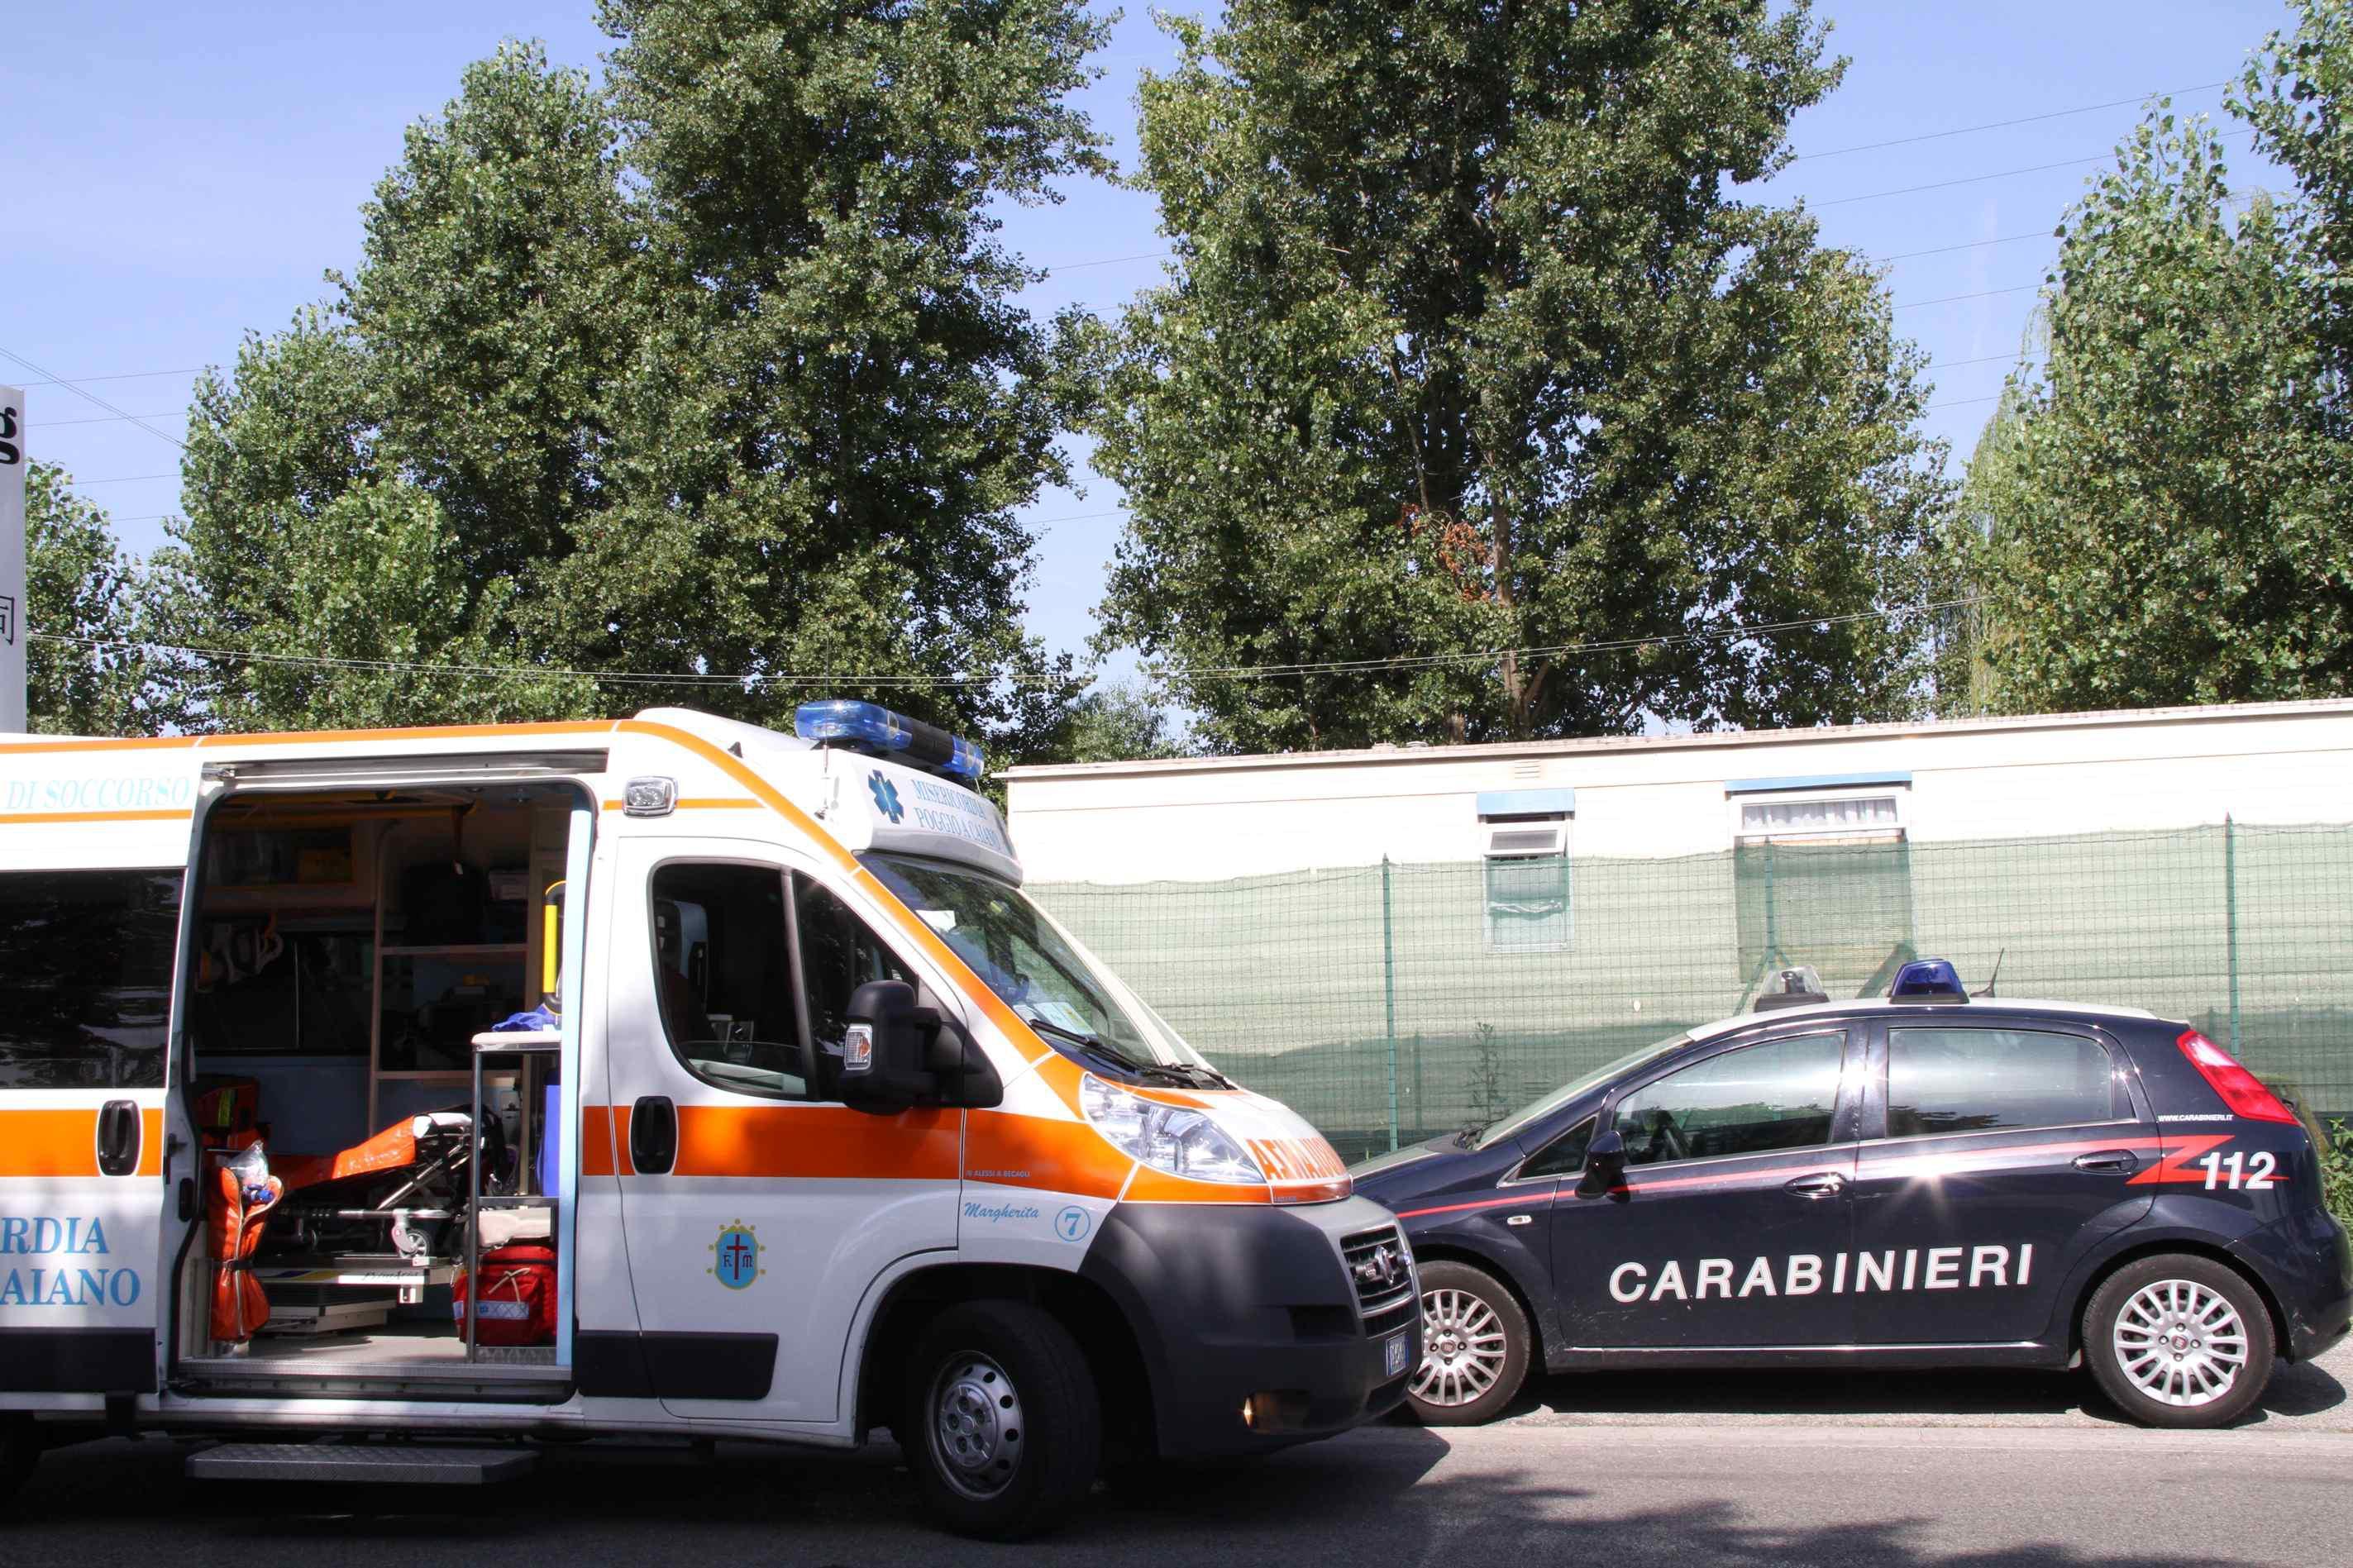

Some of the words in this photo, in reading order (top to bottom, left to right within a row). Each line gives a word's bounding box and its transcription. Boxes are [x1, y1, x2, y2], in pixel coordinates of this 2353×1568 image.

[6, 779, 41, 809] DI
[44, 775, 191, 808] SOCCORSO
[913, 807, 962, 835] POGGIO
[2156, 1113, 2234, 1123] WWW.CARABINIERI.IT
[2199, 1151, 2276, 1190] 112
[0, 1216, 110, 1255] RDIA
[964, 1202, 1039, 1222] Margherita
[1065, 1213, 1081, 1236] 7
[0, 1267, 141, 1307] AIANO
[1608, 1242, 2033, 1303] CARABINIERI
